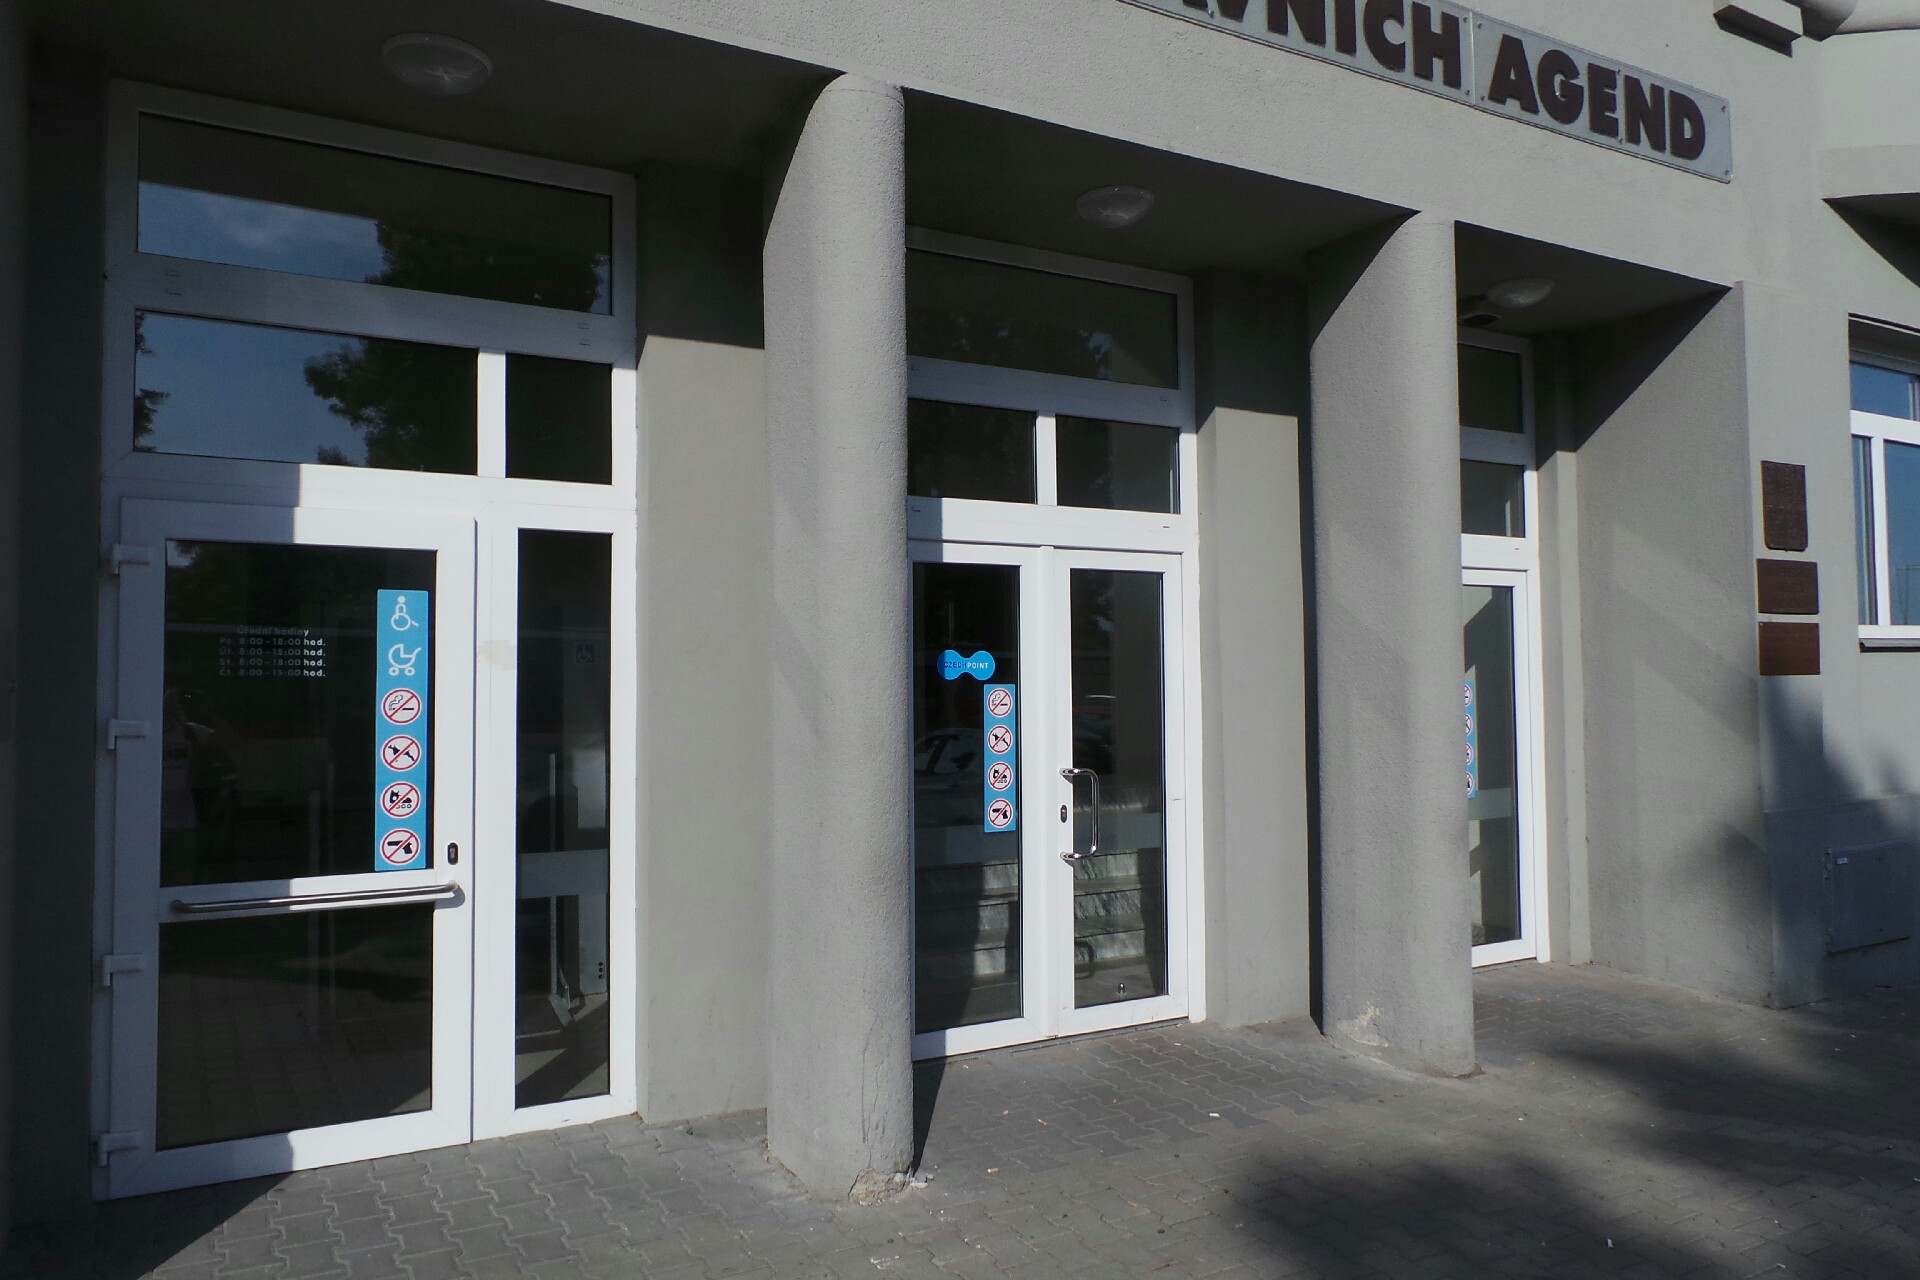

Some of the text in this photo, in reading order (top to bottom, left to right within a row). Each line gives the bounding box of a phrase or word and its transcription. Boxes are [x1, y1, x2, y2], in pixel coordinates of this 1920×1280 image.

[1488, 34, 1707, 160] AGEND
[274, 628, 310, 637] hodiny
[303, 638, 326, 646] hod.
[303, 648, 326, 656] hod.
[303, 658, 326, 666] hod.
[303, 669, 326, 677] hod.
